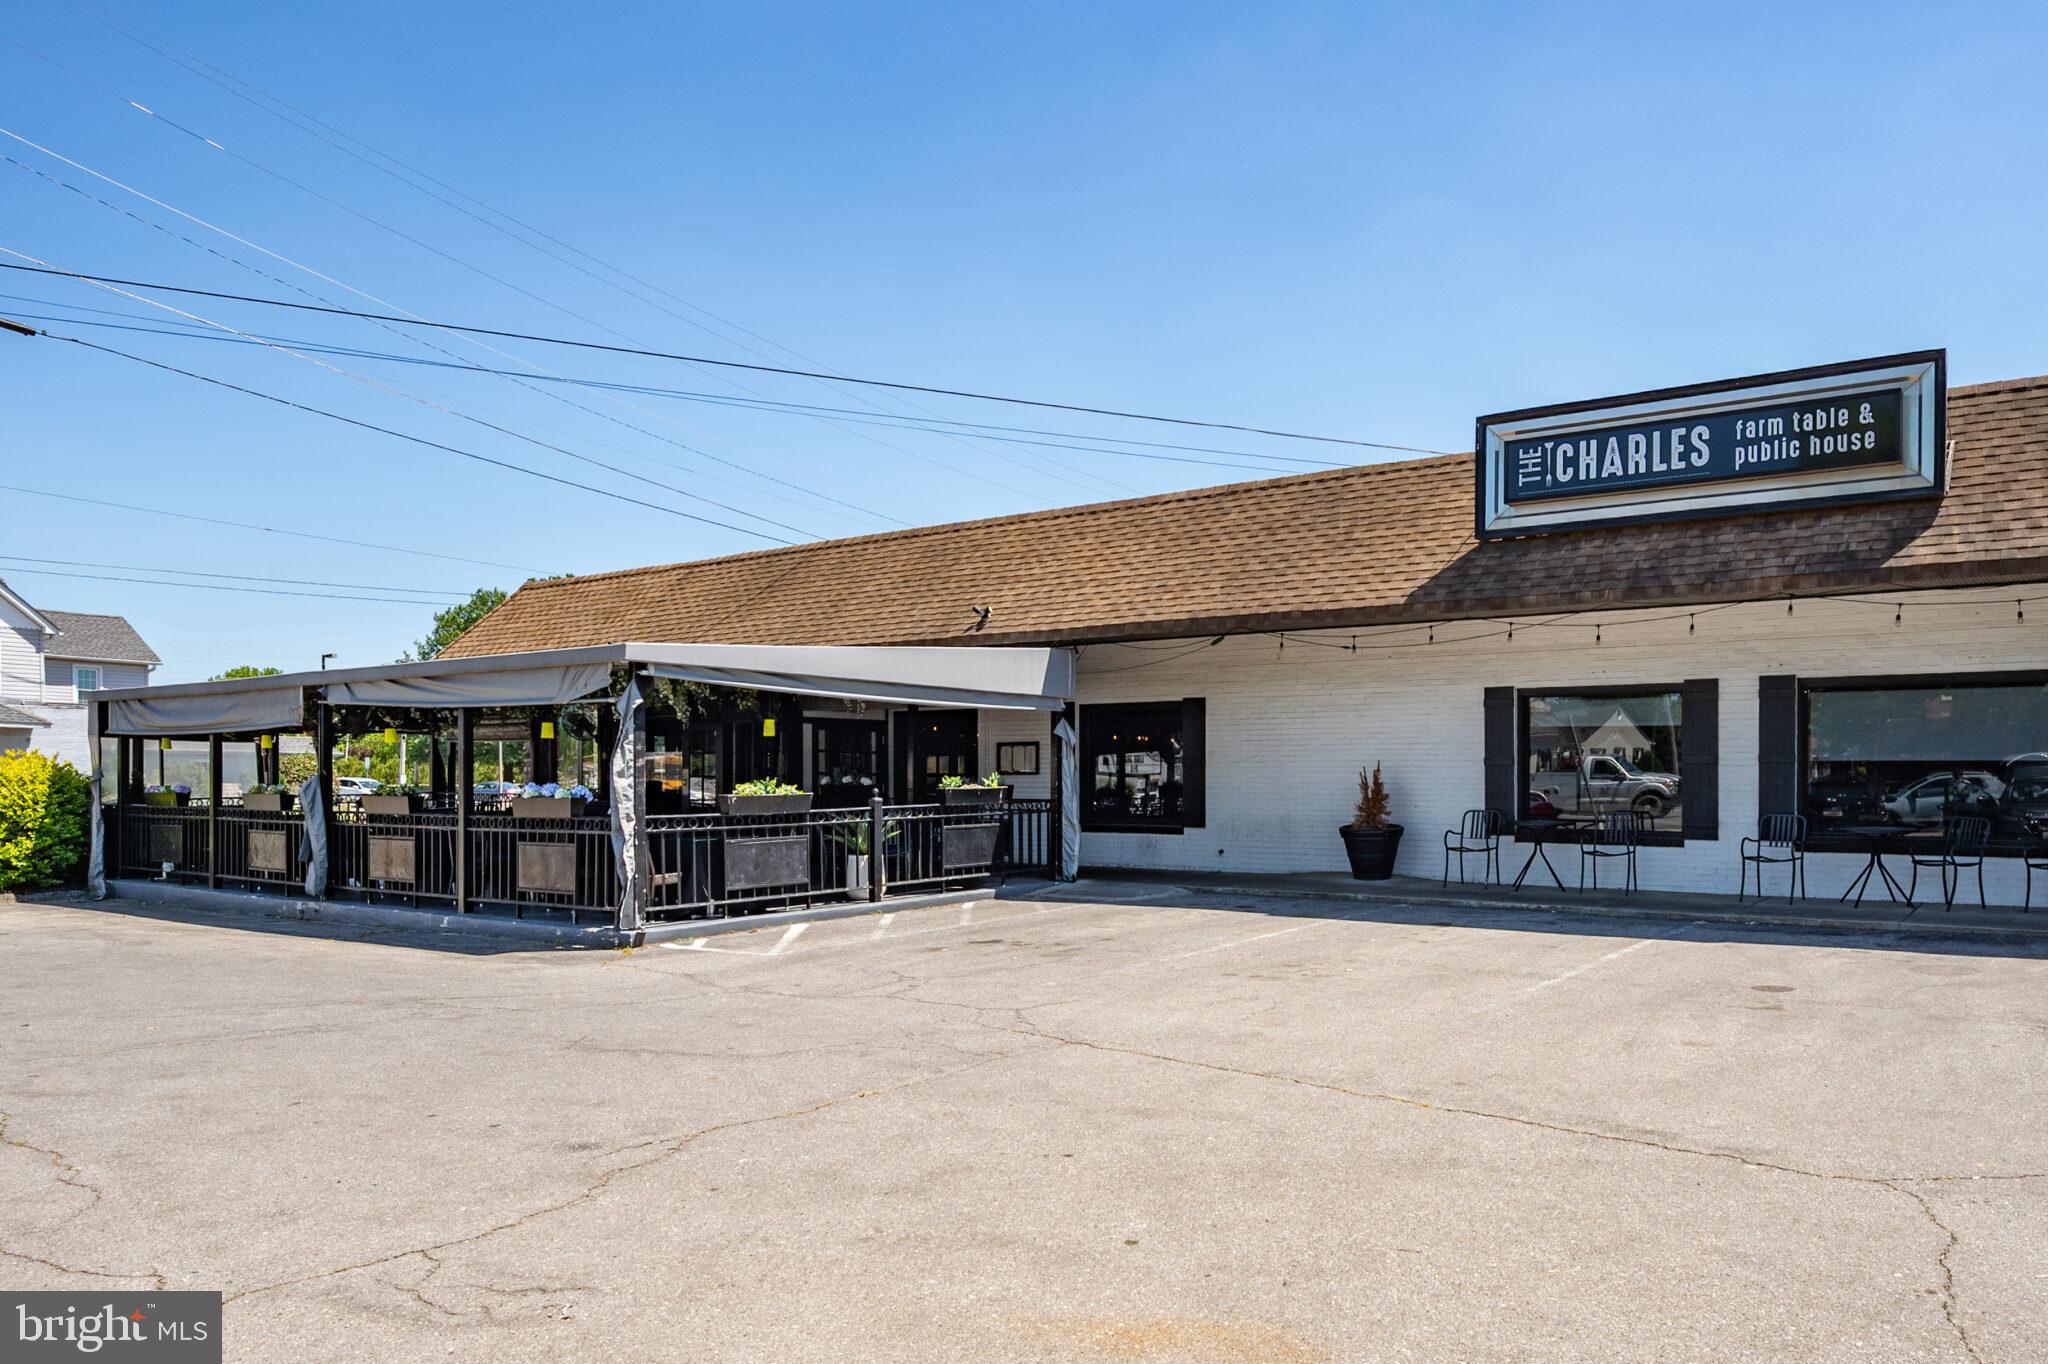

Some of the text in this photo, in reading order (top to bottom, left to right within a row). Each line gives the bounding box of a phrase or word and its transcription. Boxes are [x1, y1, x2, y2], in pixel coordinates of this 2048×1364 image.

[1735, 402, 1875, 441] farm table &
[1518, 446, 1542, 487] THE
[1555, 425, 1710, 483] CHARLES
[1735, 430, 1876, 470] public house
